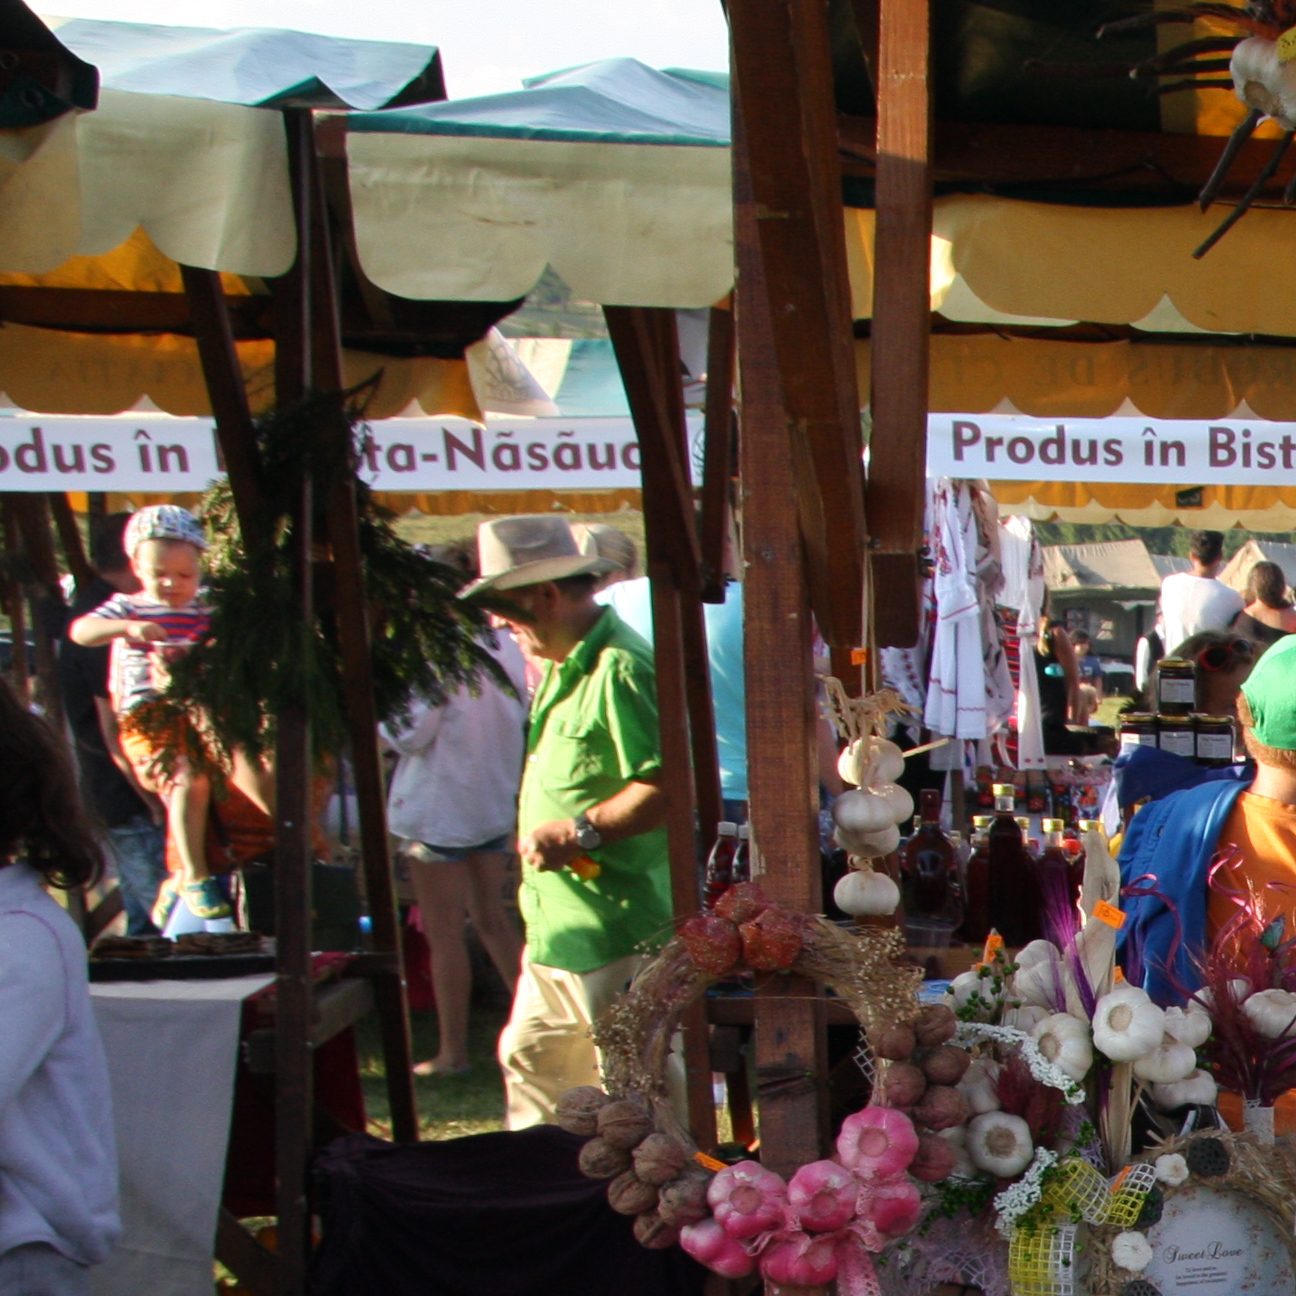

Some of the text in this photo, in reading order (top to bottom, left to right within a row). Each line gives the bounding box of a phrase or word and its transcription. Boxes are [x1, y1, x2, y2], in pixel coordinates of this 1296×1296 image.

[134, 428, 191, 473] în
[951, 420, 1125, 466] Produs
[1141, 426, 1187, 468] în
[1163, 1240, 1244, 1265] Sweet Love
